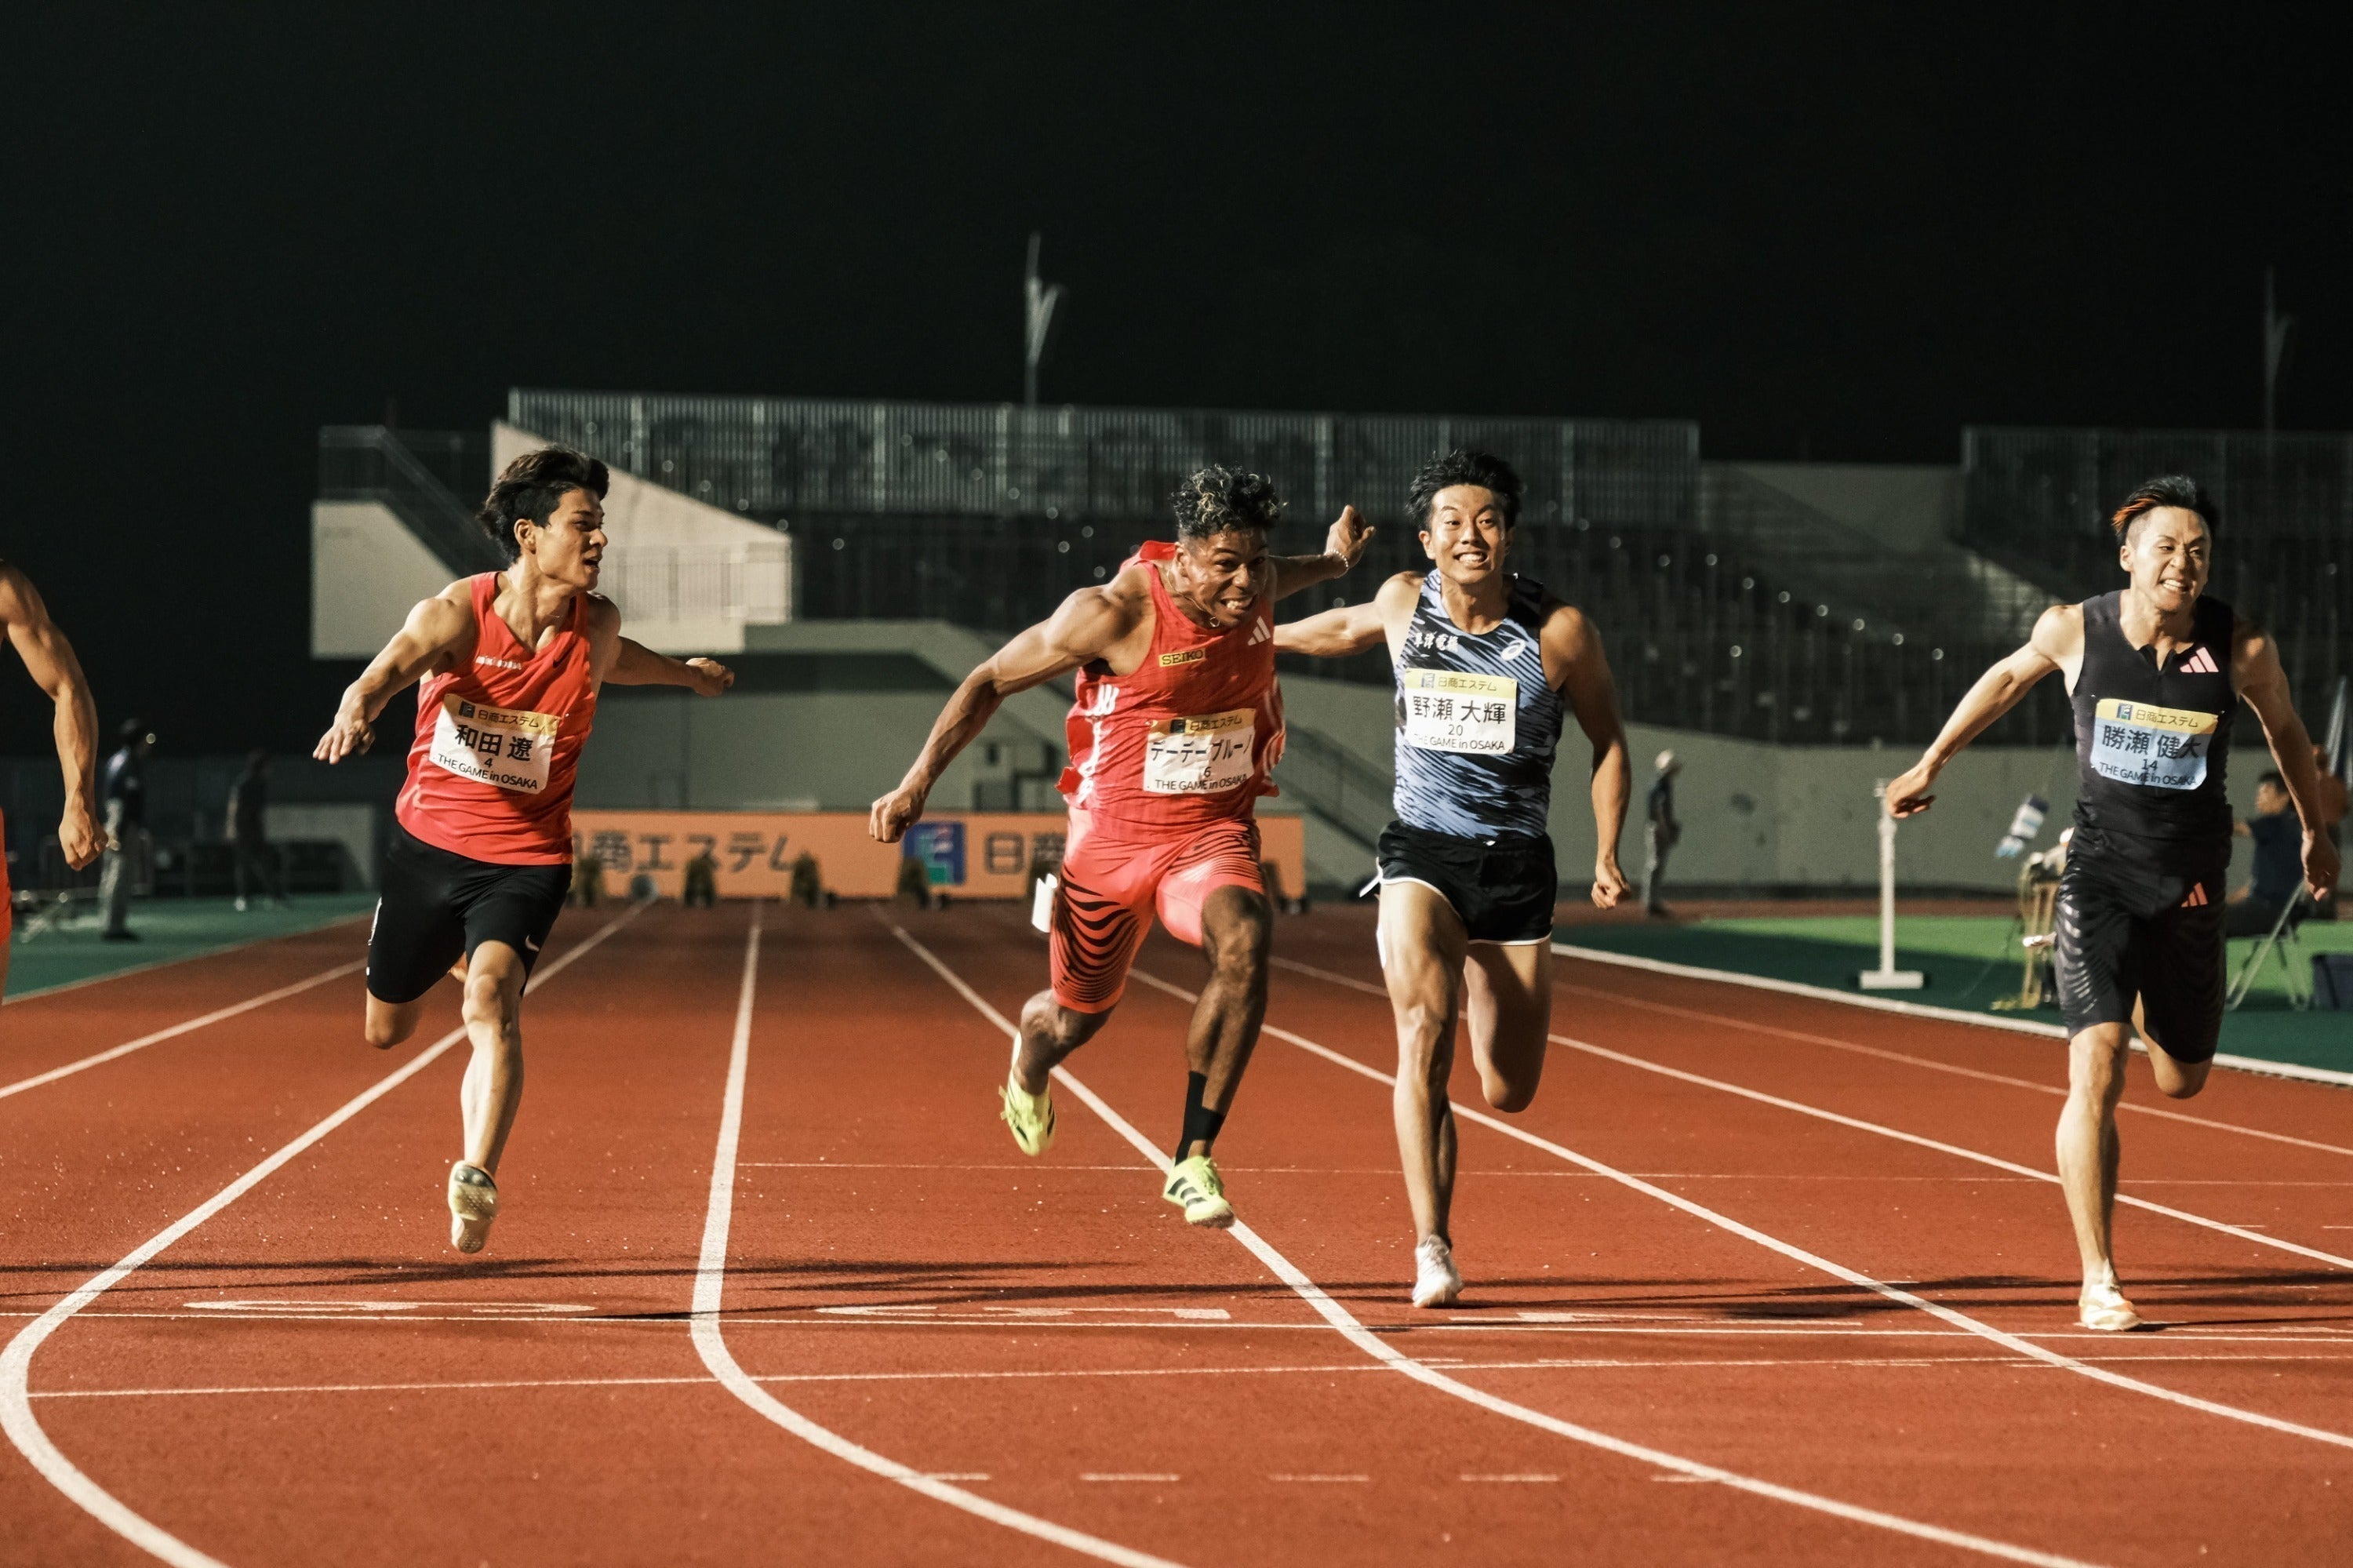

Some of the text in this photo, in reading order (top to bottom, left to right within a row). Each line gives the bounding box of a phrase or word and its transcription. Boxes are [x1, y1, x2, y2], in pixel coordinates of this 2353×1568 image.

[1161, 649, 1203, 665] SEIKO
[1438, 677, 1497, 691] 日商エステム
[478, 709, 539, 728] 日商エステム
[1413, 696, 1506, 724] 野瀬 大輝
[2136, 709, 2198, 728] 日商エステム
[1190, 715, 1242, 730] 日商エステム
[1448, 724, 1464, 736] 20
[455, 724, 533, 762] 和田 遼
[1430, 737, 1457, 748] GAME
[1459, 739, 1468, 748] in
[1469, 740, 1505, 750] OSAKA
[2102, 725, 2202, 759] 勝瀬 健大
[438, 754, 537, 790] THE GAME in OSAKA
[484, 758, 493, 769] 4
[1203, 766, 1212, 777] 6
[2141, 759, 2158, 771] 14
[1155, 773, 1247, 791] THE GAME in OSAKA
[2100, 762, 2118, 776] THE
[2120, 769, 2149, 782] GAME
[2151, 773, 2161, 784] in
[573, 830, 802, 872] 商エステム
